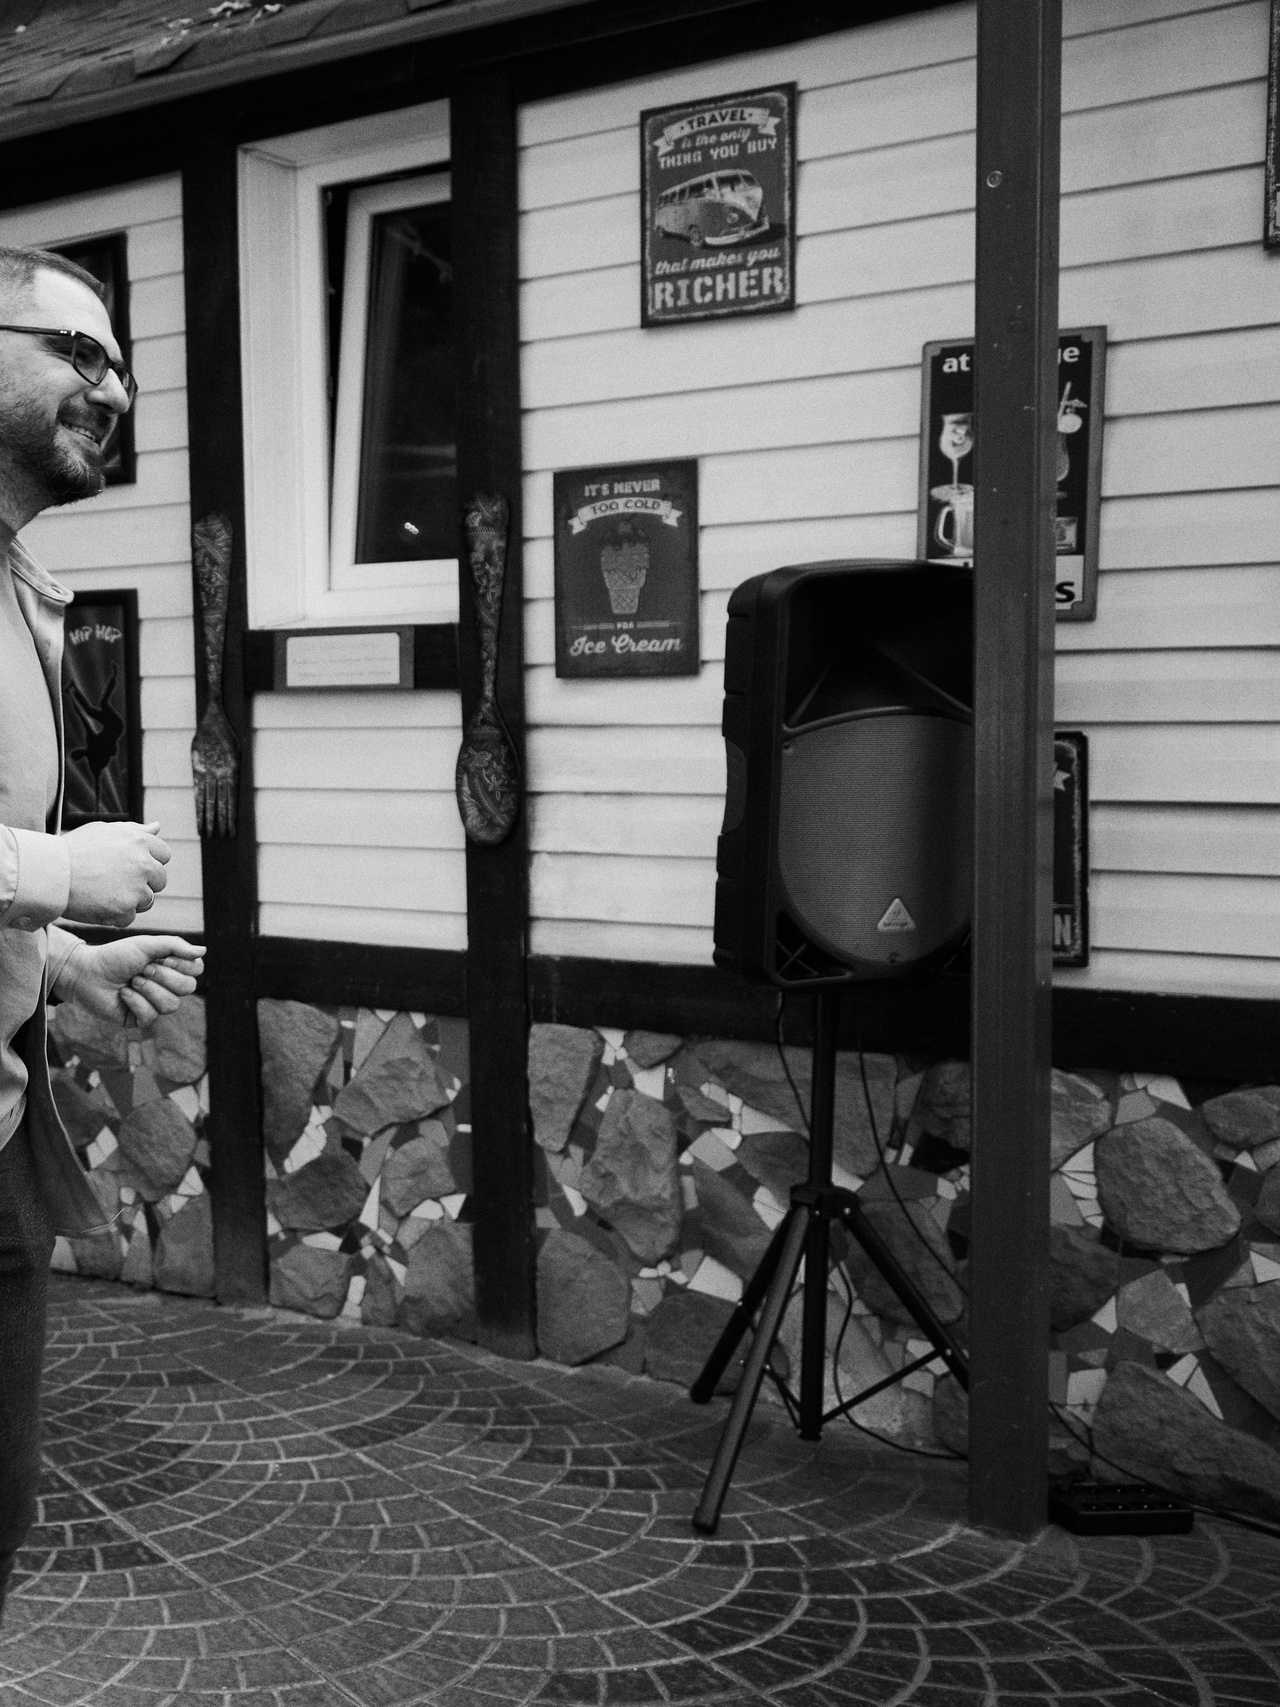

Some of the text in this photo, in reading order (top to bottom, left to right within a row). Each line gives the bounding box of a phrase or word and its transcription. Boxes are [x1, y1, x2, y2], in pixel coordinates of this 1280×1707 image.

[686, 109, 746, 130] TRAVEL
[681, 127, 751, 149] is the only
[659, 137, 778, 169] THING YOU BUY
[654, 247, 780, 276] that makes you
[654, 266, 783, 310] RICHER
[942, 352, 971, 373] at
[584, 478, 661, 497] IT'S NEVER
[591, 499, 660, 514] TOO COLD
[69, 623, 122, 645] HIP HOP
[569, 633, 683, 657] Ice Cream
